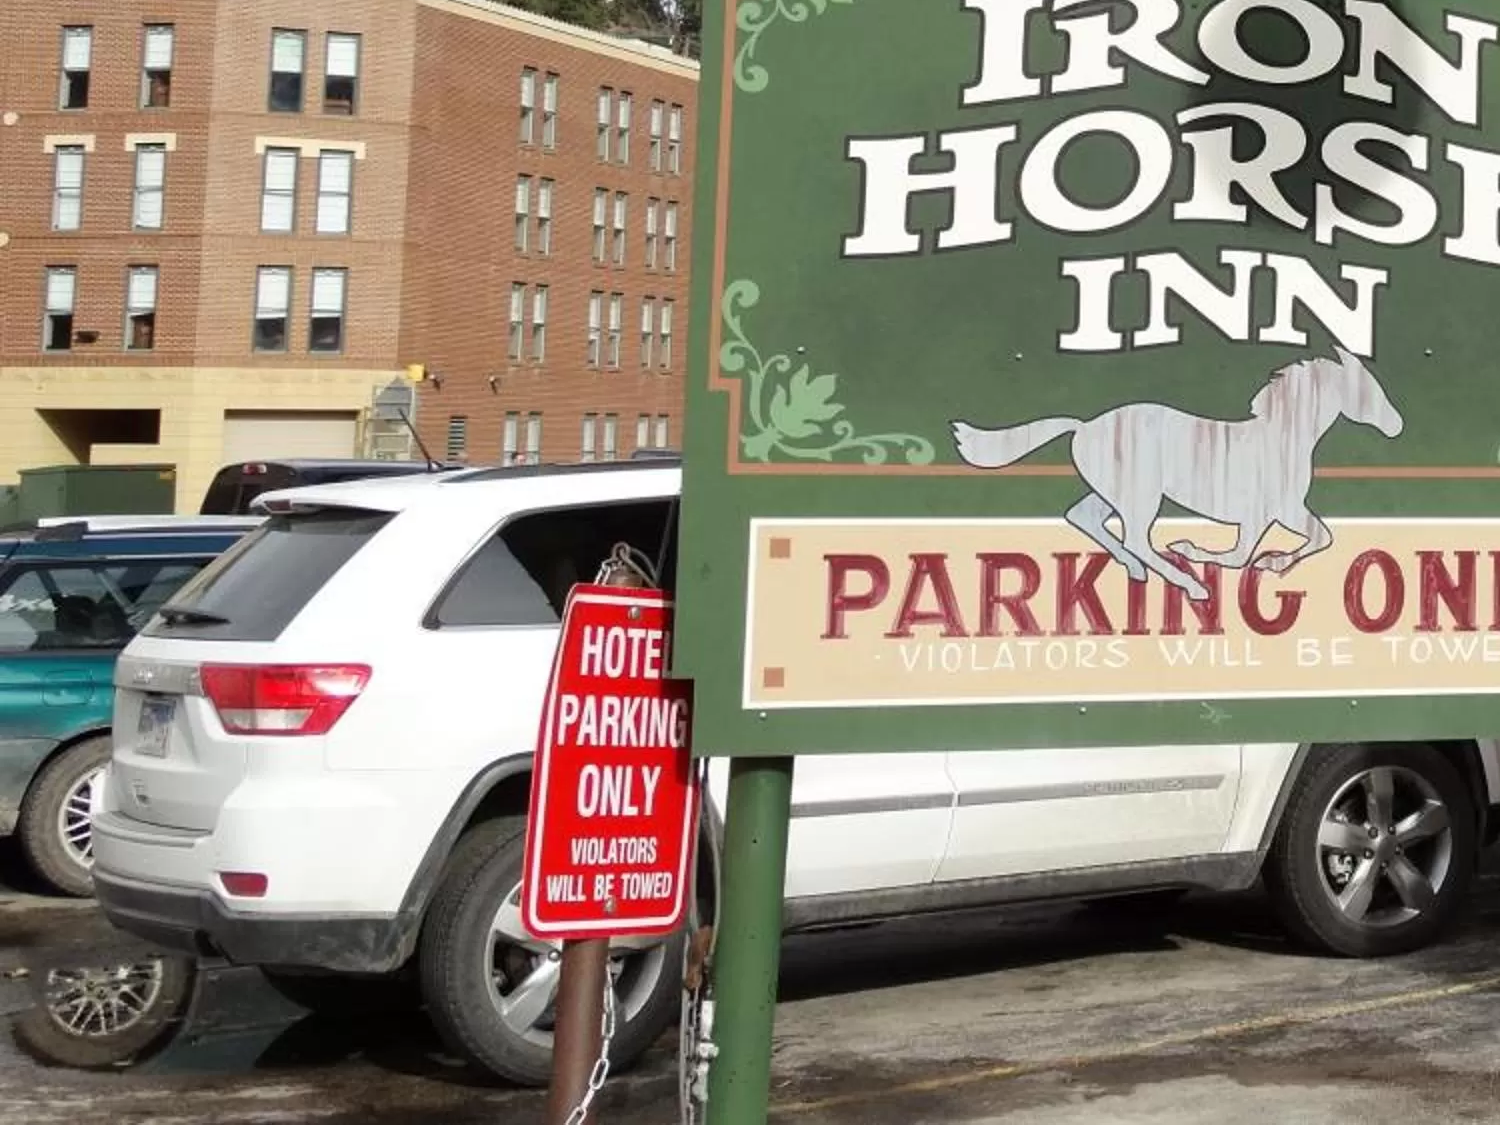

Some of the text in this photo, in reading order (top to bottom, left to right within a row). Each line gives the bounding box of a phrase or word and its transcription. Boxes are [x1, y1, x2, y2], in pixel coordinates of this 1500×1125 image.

[1057, 250, 1390, 358] INN
[820, 550, 1308, 640] PARKING
[581, 625, 672, 679] HOTEL
[898, 638, 1131, 672] VIOLATORS
[1157, 637, 1263, 668] WILL
[1295, 637, 1355, 667] BE
[558, 694, 688, 748] PARKING
[577, 764, 661, 818] ONLY
[571, 836, 657, 866] VIOLATORS
[546, 871, 672, 903] WILL BE TOWED
